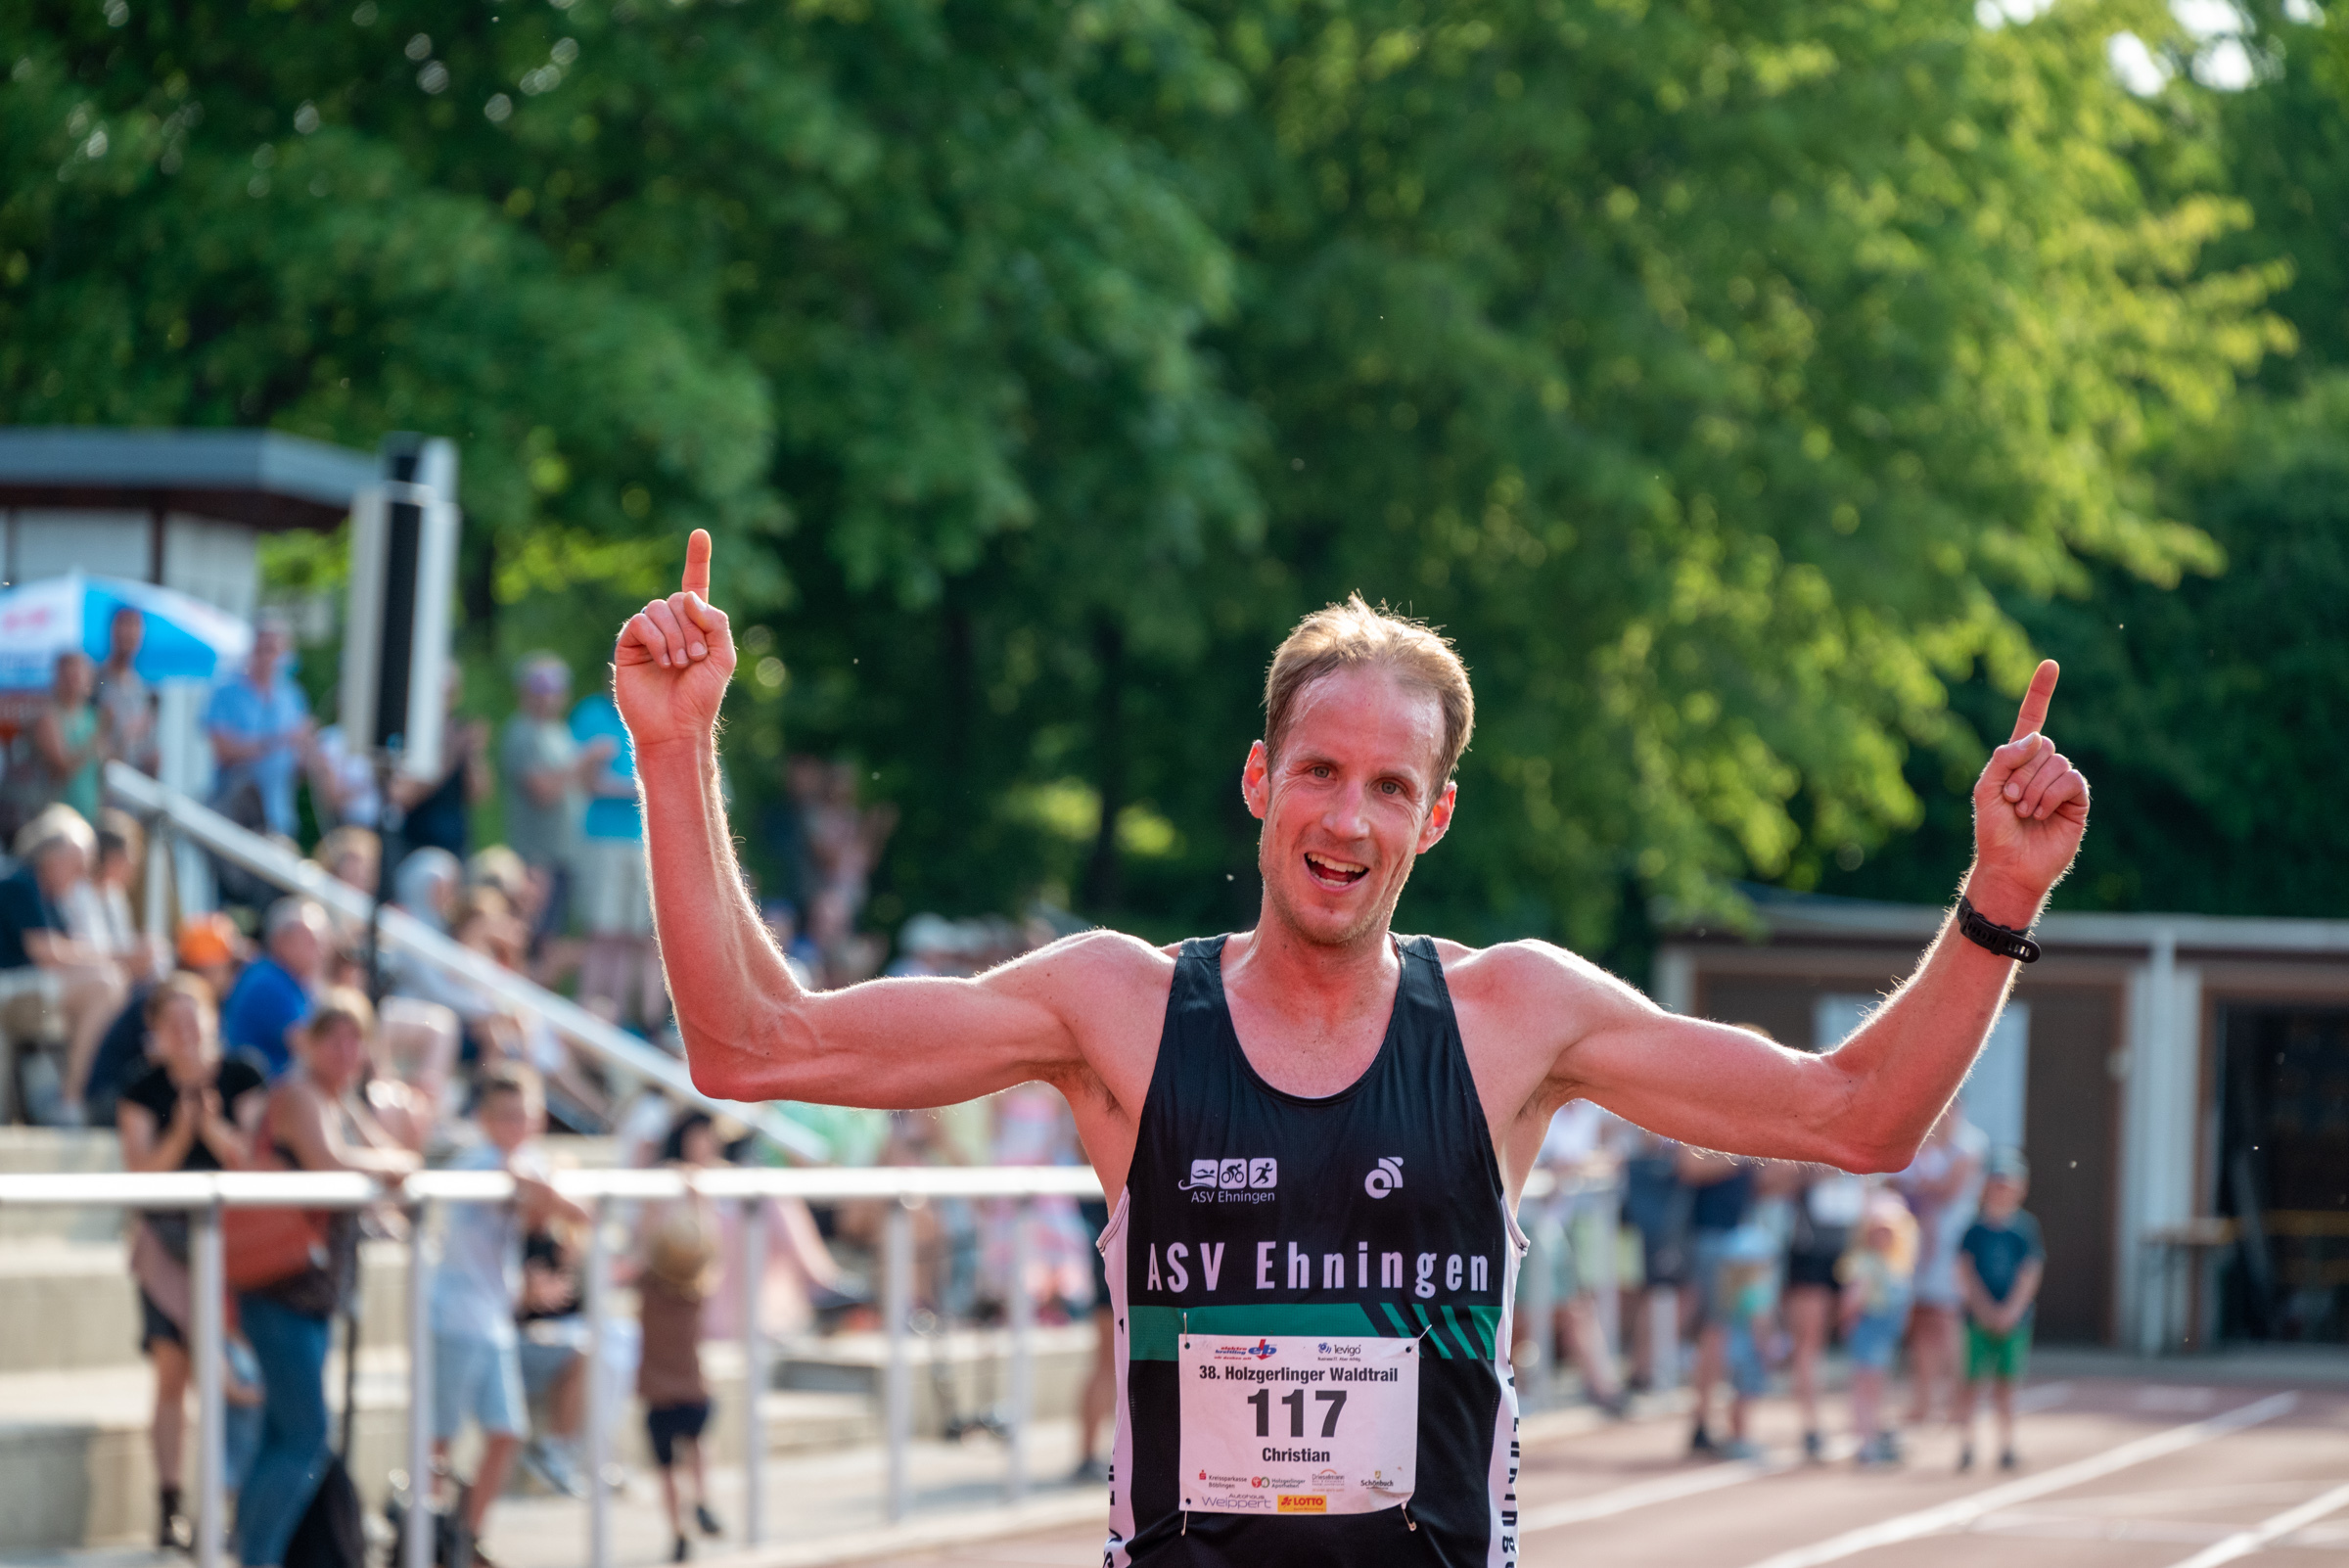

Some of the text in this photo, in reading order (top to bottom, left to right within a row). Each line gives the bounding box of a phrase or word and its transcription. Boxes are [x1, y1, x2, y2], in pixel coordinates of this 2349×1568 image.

[1190, 1190, 1275, 1205] ASV Ehningen
[1147, 1241, 1489, 1299] ASV Ehningen
[1199, 1365, 1399, 1384] 38. Holzgerlinger Waldtrail
[1247, 1388, 1348, 1438] 117
[1262, 1448, 1330, 1462] Christian
[1201, 1497, 1271, 1509] Weippert
[1293, 1498, 1324, 1506] LOTTO
